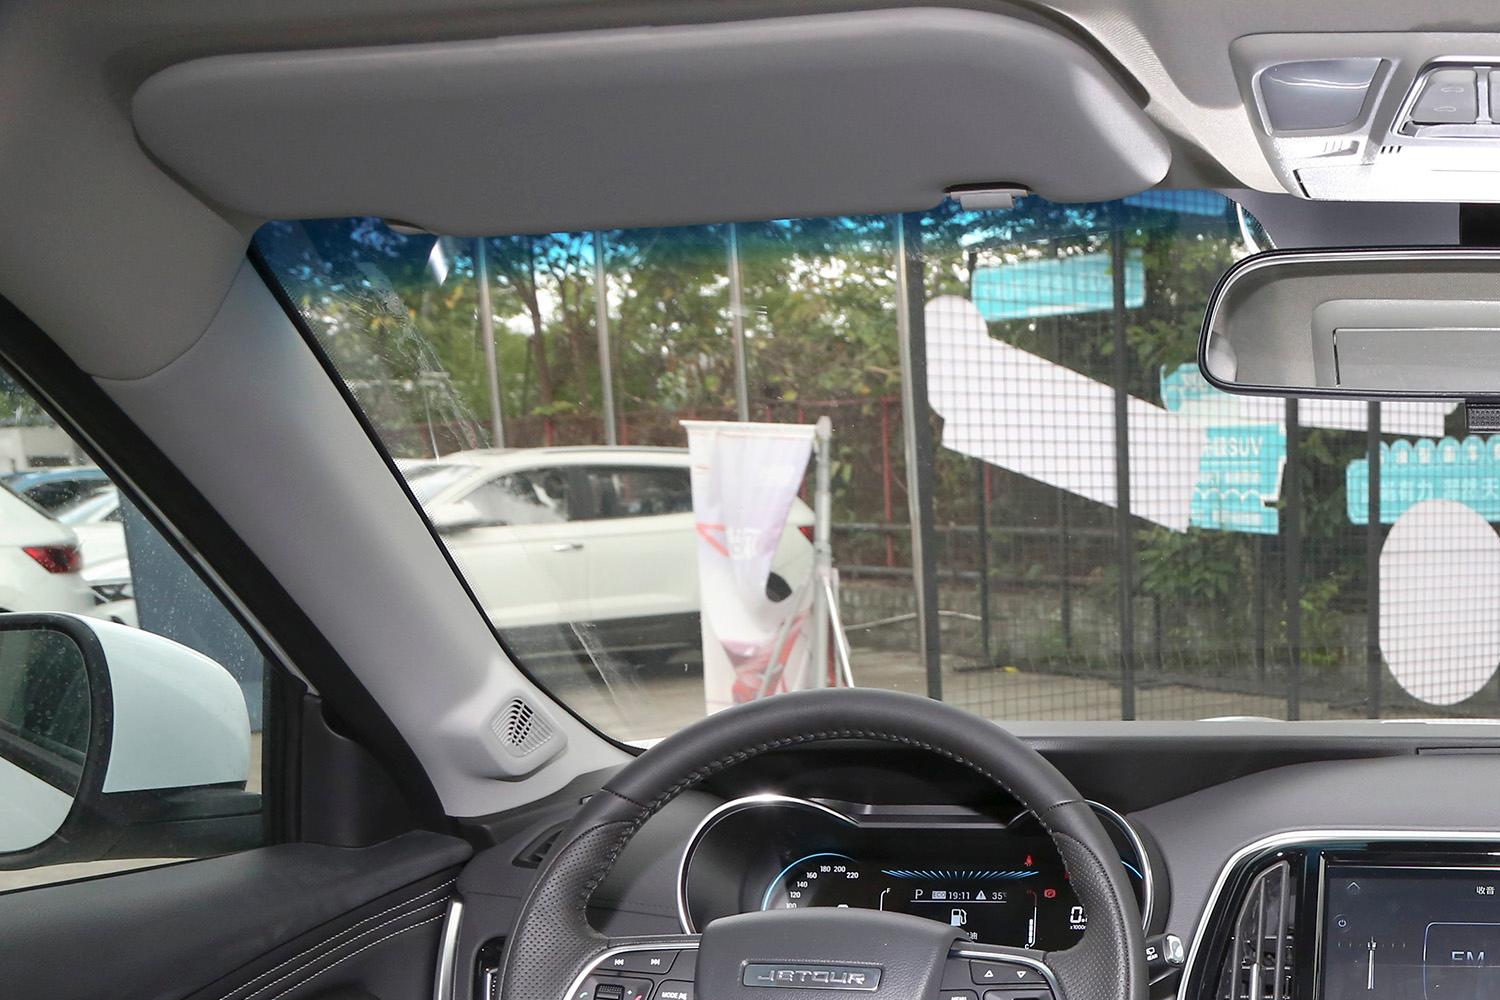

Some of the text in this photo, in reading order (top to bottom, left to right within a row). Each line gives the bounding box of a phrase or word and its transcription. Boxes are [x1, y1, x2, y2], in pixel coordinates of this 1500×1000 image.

[915, 889, 923, 899] P
[932, 891, 946, 899] ECO
[949, 891, 970, 900] 19:11
[1476, 886, 1495, 895] 收音
[757, 970, 865, 985] JETOUR
[661, 991, 678, 999] MODE
